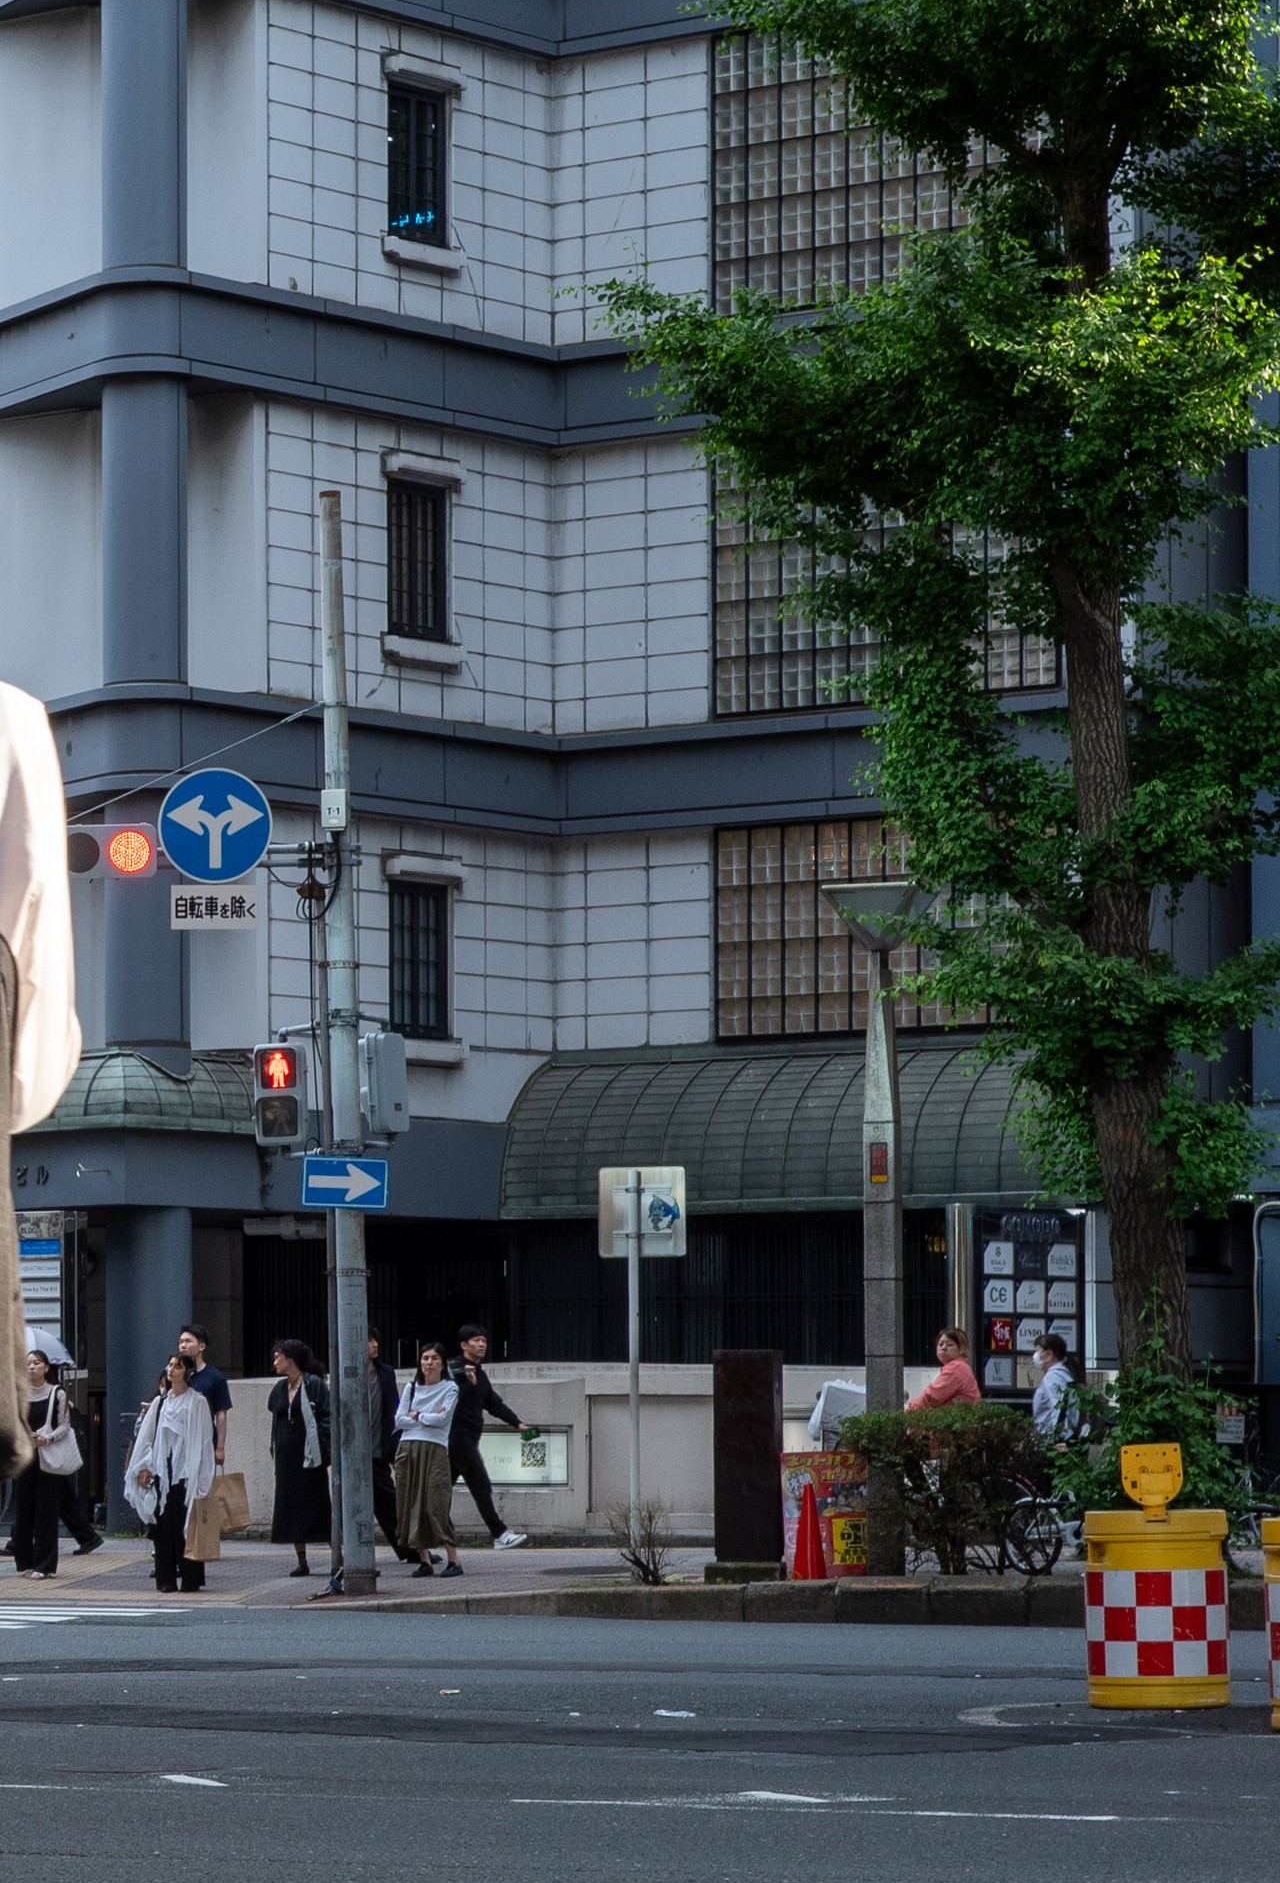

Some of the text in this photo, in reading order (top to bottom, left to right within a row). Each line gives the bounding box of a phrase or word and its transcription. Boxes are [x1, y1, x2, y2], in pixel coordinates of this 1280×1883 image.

[327, 807, 340, 815] T-1
[173, 895, 257, 920] 自転車を除く
[1001, 1215, 1061, 1234] COMODO
[1048, 1300, 1074, 1308] Garland
